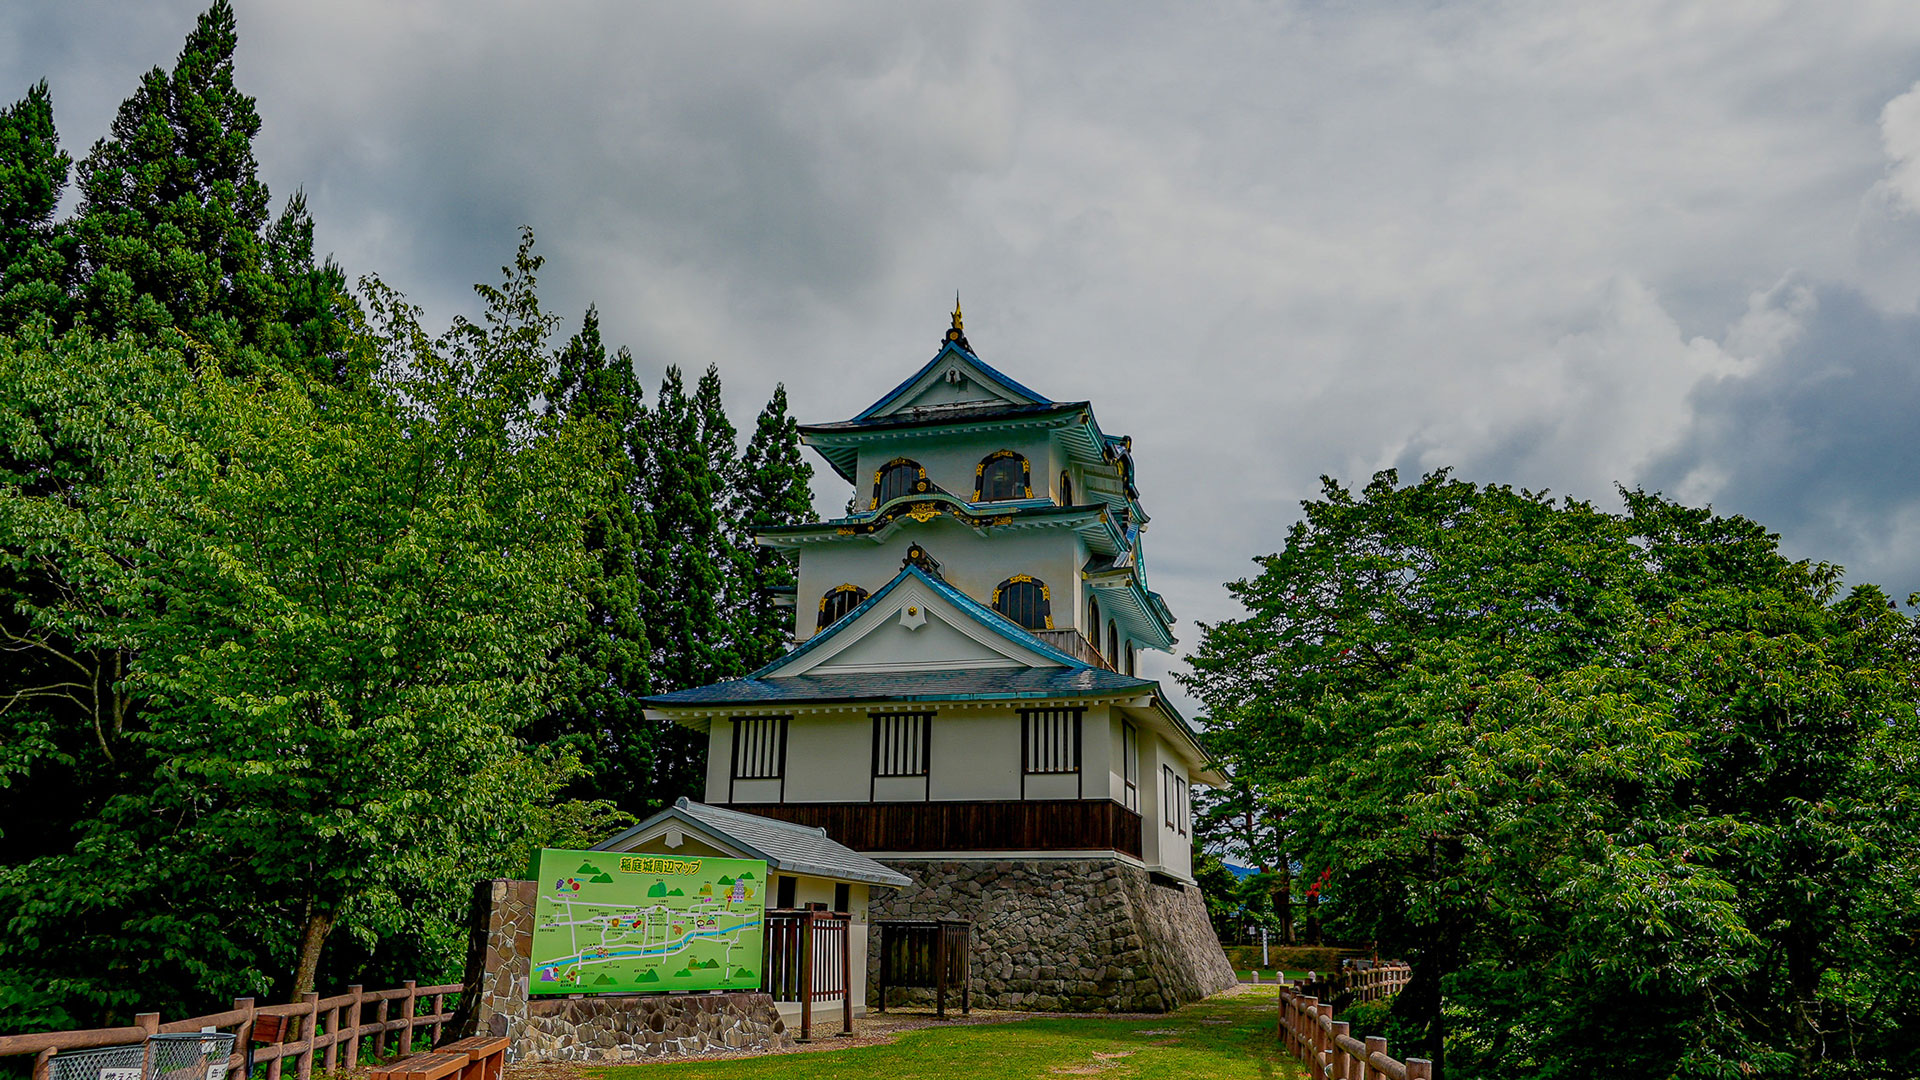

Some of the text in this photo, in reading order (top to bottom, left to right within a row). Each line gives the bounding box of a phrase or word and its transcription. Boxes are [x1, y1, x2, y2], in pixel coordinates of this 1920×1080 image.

[620, 857, 701, 876] 稲庭城周辺マップ
